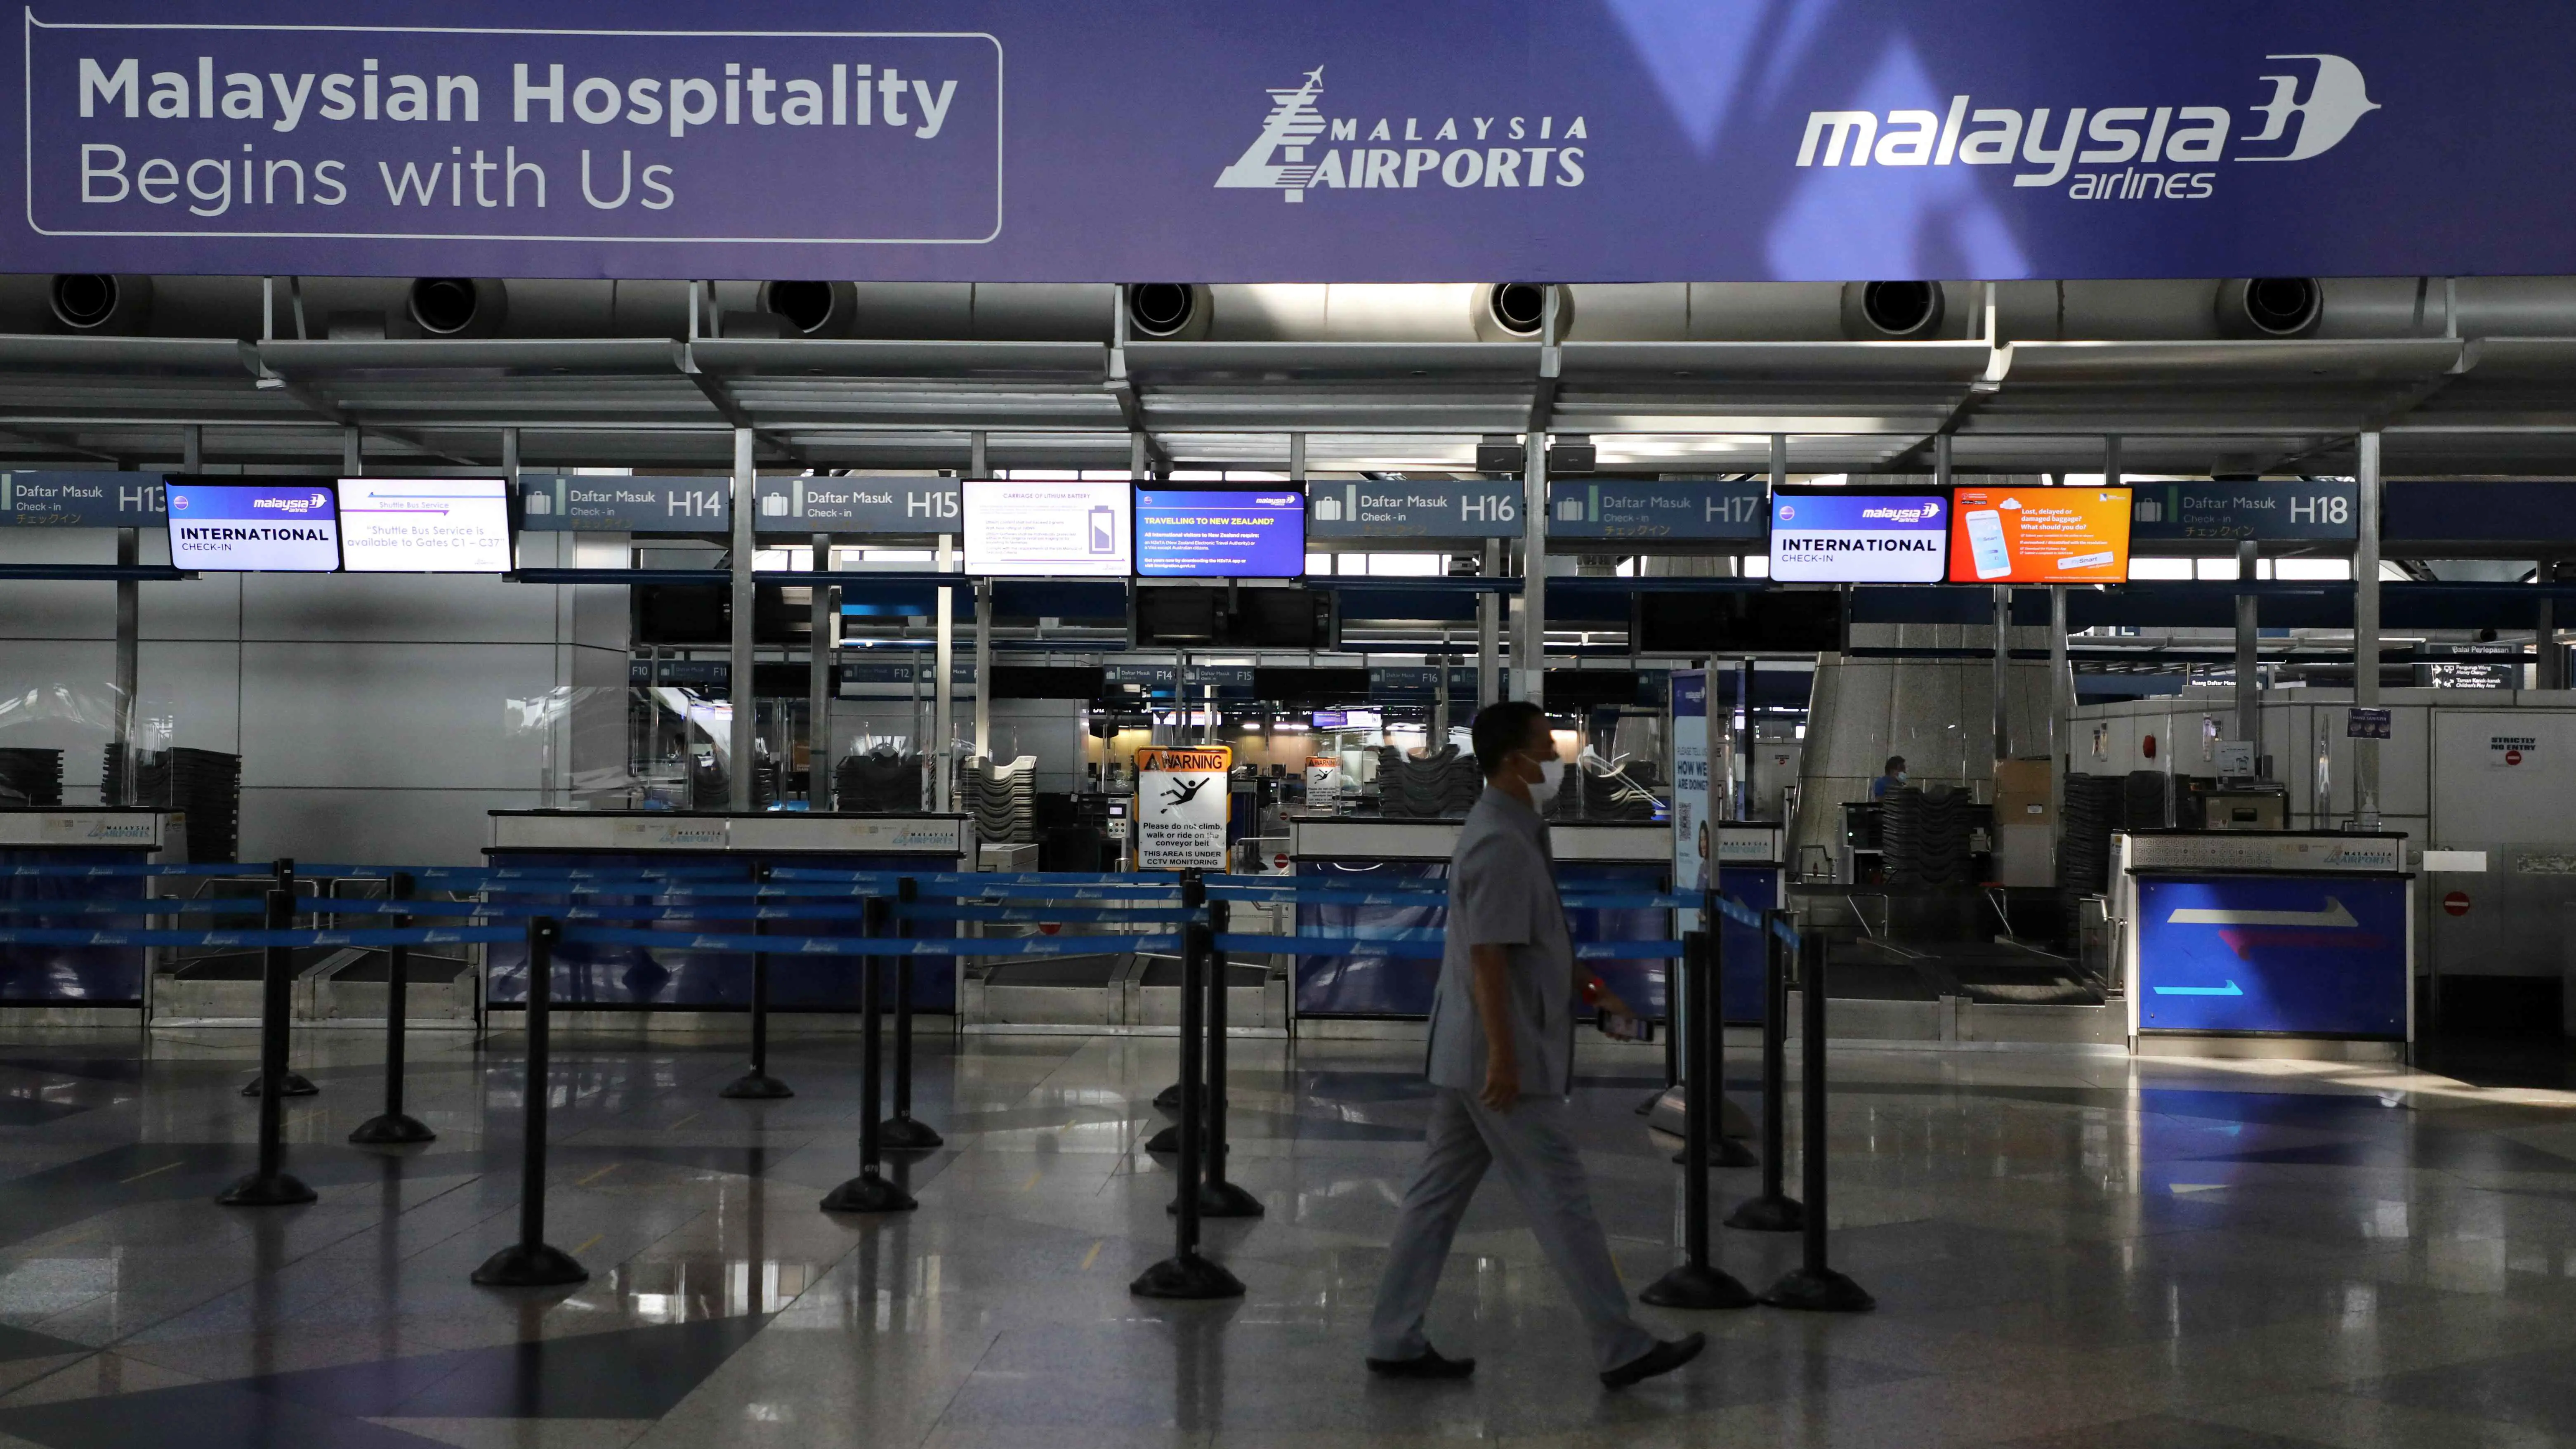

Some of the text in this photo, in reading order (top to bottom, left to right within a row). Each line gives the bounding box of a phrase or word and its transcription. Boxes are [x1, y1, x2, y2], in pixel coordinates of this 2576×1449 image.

[80, 57, 958, 139] Malaysian Hospitality
[1329, 117, 1588, 141] MALAYSIA
[1795, 96, 2230, 186] malaysia
[1307, 146, 1586, 188] AIRPORTS
[81, 144, 675, 217] Begins with Us
[2068, 171, 2215, 200] airlines
[17, 486, 102, 498] Daftar Masuk
[571, 490, 655, 502] Daftar Masuk
[808, 491, 892, 503] Daftar Masuk
[253, 498, 309, 512] malaysia
[668, 491, 721, 517] H14
[908, 492, 958, 517] H15
[1362, 496, 1447, 507] Daftar Masuk
[1604, 496, 1691, 508] Daftar Masuk
[2184, 497, 2275, 508] Daftar Masuk
[1462, 496, 1514, 521] H16
[1706, 497, 1758, 522] H17
[1862, 507, 1920, 522] malaysia
[2291, 497, 2347, 523] H18
[181, 528, 329, 541] INTERNATIONAL
[412, 526, 429, 535] Bus
[433, 526, 472, 536] Service
[476, 526, 484, 535] is
[182, 543, 232, 551] CHECK-IN
[347, 538, 397, 547] available
[402, 538, 412, 547] to
[416, 538, 448, 547] Gates
[452, 538, 465, 547] C1
[1783, 539, 1936, 551] INTERNATIONAL
[632, 667, 647, 675] F10
[714, 668, 727, 676] F11
[894, 668, 909, 677] F12
[1157, 671, 1172, 680] F14
[1237, 672, 1252, 680] F15
[1422, 673, 1437, 682] F16
[1163, 754, 1222, 769] WARNING
[1677, 761, 1707, 776] HOW WE
[1677, 778, 1688, 789] ARE
